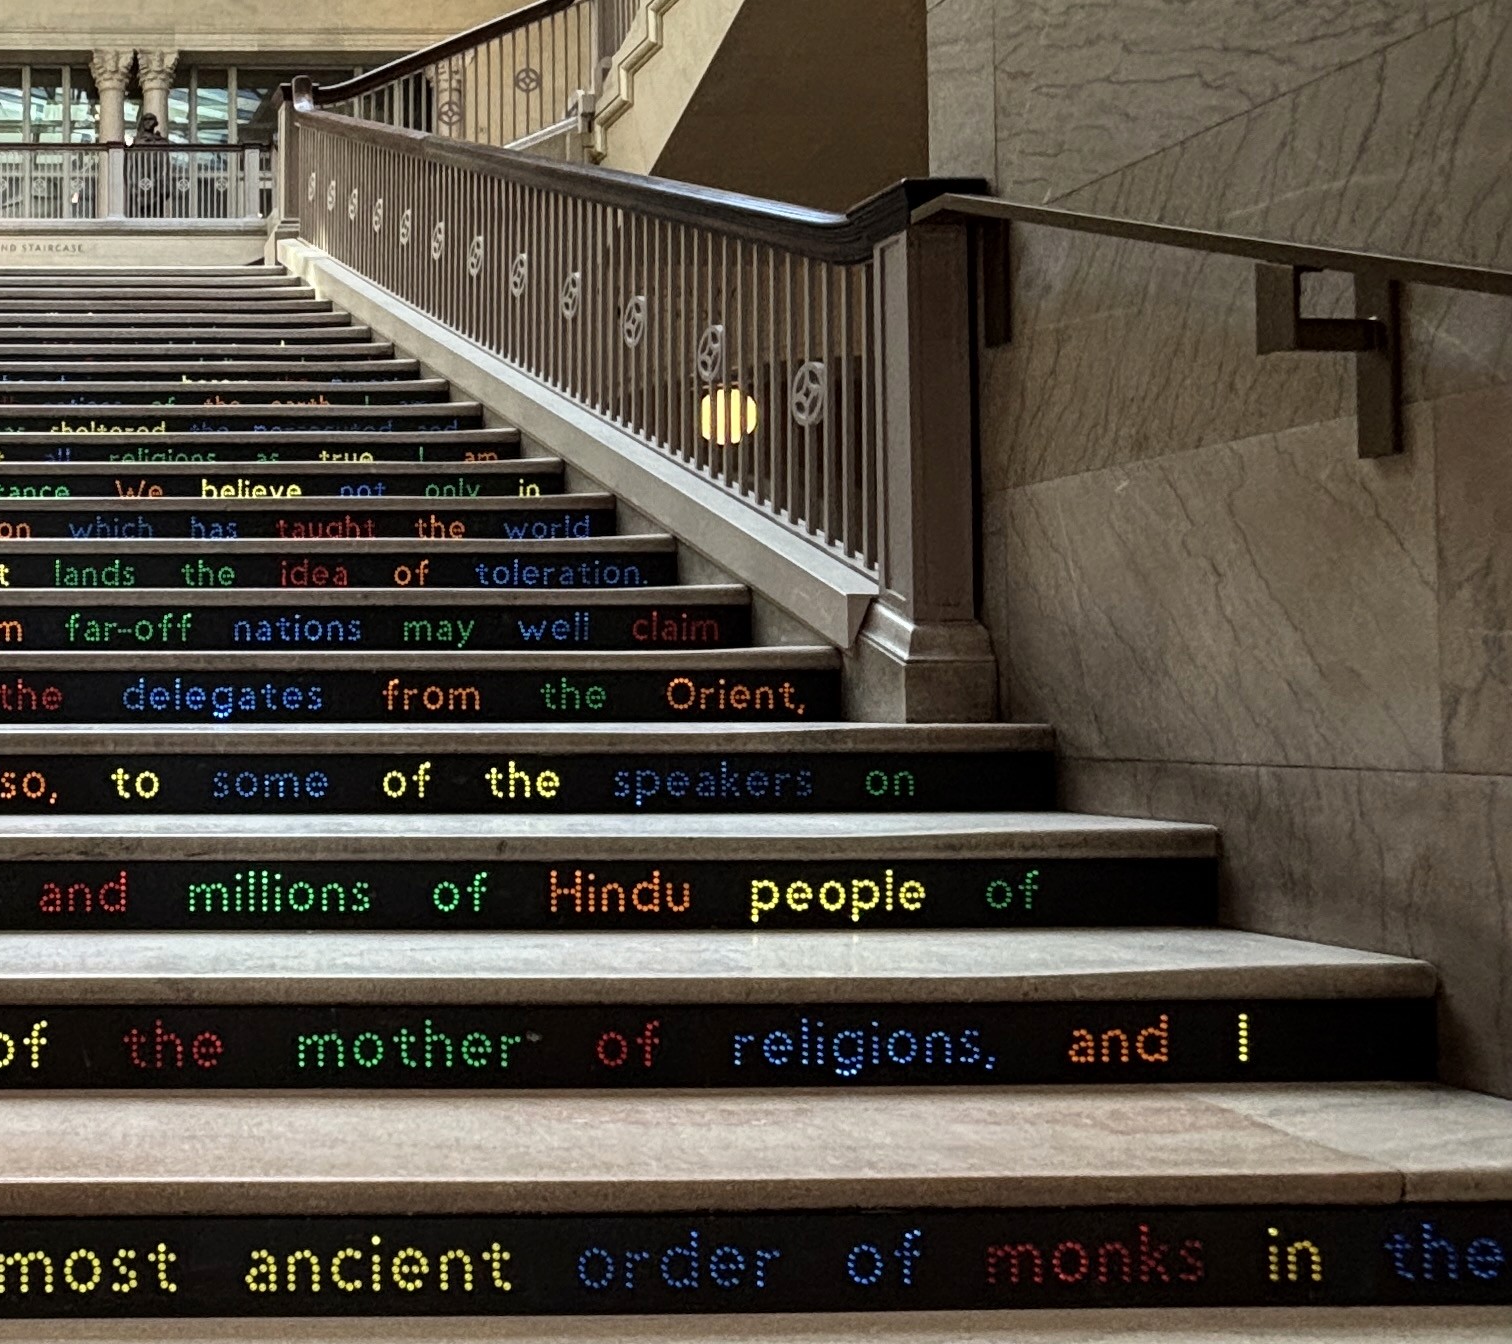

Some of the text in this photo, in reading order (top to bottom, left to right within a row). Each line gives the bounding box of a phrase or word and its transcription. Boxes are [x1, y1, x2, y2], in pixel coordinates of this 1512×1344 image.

[21, 243, 84, 253] STAIRCASE
[69, 518, 154, 539] which
[189, 517, 239, 539] has
[276, 514, 375, 539] taught
[415, 513, 466, 539] the
[503, 515, 592, 539] world
[54, 559, 136, 588] lands
[182, 559, 236, 587] the
[279, 559, 349, 589] idea
[393, 558, 430, 589] of
[476, 560, 647, 586] toleration.
[66, 611, 192, 642] far-off
[233, 616, 361, 643] nations
[403, 619, 476, 649] may
[519, 612, 589, 641] well
[631, 609, 720, 641] claim
[122, 678, 323, 721] delegates
[382, 677, 481, 711] from
[540, 676, 608, 711] the
[665, 675, 806, 716] Orient,
[110, 767, 161, 800] to
[212, 770, 329, 799] some
[382, 761, 432, 799] of
[487, 760, 561, 799] the
[613, 759, 812, 808] speakers
[864, 769, 915, 797] on
[38, 869, 129, 913] and
[188, 869, 371, 913] millions
[432, 870, 488, 913] of
[549, 869, 691, 913] Hindu
[749, 870, 926, 924] people
[984, 868, 1040, 911] of
[122, 1019, 224, 1070] the
[297, 1020, 520, 1068] mother
[596, 1019, 664, 1067] of
[733, 1017, 996, 1076] religions,
[1067, 1013, 1169, 1064] and
[1238, 1012, 1250, 1063] I
[244, 1234, 512, 1293] ancient
[576, 1230, 782, 1292] order
[846, 1228, 922, 1287] of
[985, 1230, 1206, 1286] monks
[1267, 1227, 1322, 1282] in
[1383, 1222, 1506, 1280] the
